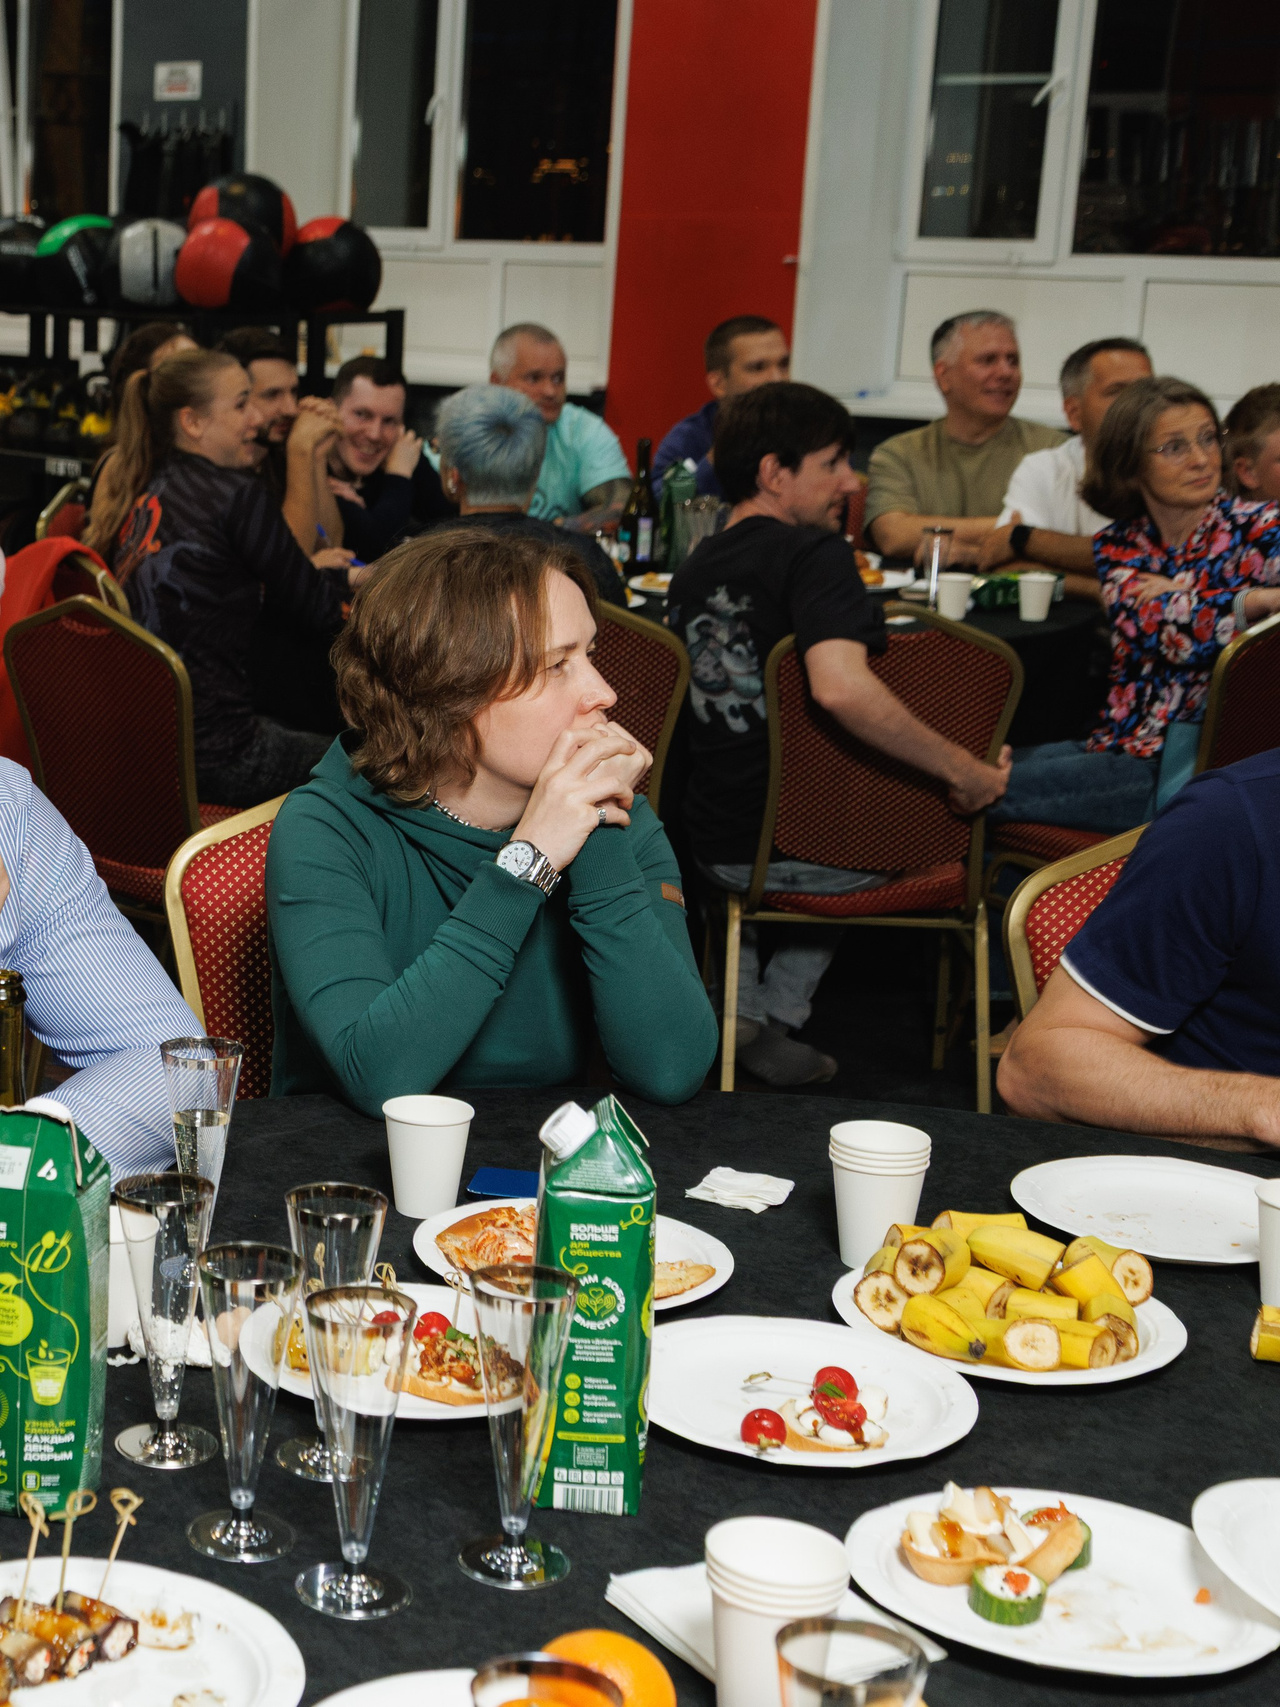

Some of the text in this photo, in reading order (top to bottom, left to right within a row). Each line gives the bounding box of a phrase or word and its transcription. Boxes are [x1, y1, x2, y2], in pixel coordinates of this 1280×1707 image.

[570, 1223, 619, 1234] БОЛЬШЕ
[570, 1232, 619, 1242] ПОЛЬЗЫ
[570, 1249, 622, 1258] общества
[602, 1276, 626, 1313] ДОБРО
[573, 1313, 619, 1330] ВМЕСТЕ
[59, 1420, 76, 1428] как
[24, 1431, 75, 1444] КАЖДЫЙ
[24, 1444, 54, 1452] ДЕНЬ
[24, 1450, 73, 1462] ДОБРЫМ
